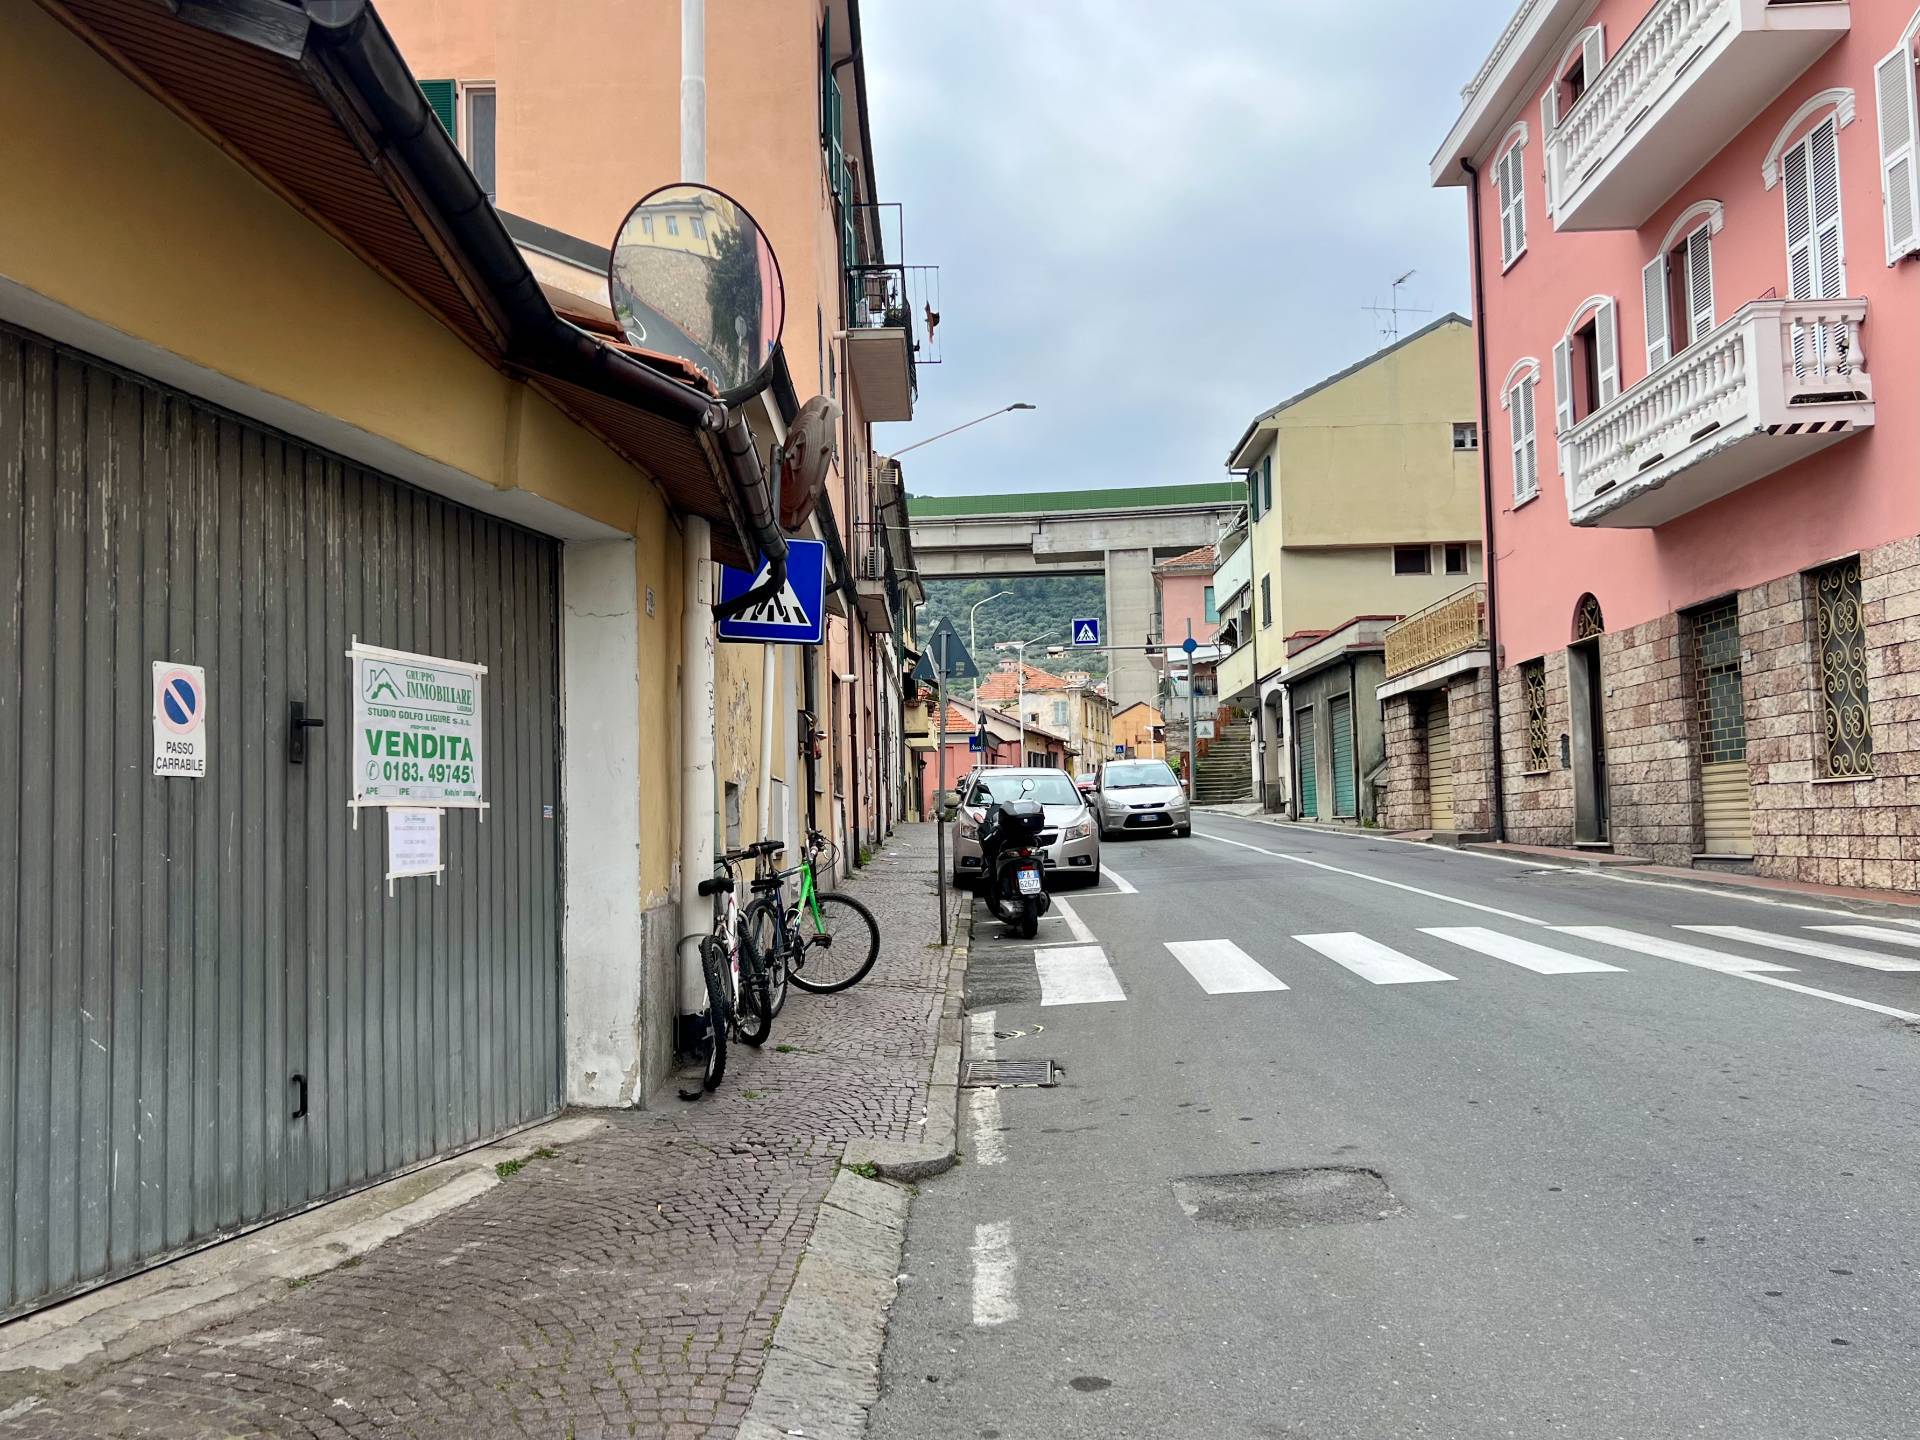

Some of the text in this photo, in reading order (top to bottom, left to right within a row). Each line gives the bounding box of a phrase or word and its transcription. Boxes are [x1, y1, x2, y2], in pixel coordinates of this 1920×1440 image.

[406, 669, 435, 682] GRUPPO
[406, 681, 472, 705] IMMOBILIARE
[367, 707, 396, 718] STUDIO
[398, 711, 423, 721] GOLFO
[425, 713, 451, 724] LIGURE
[166, 741, 194, 755] PASSO
[365, 729, 473, 761] VENDITA
[155, 756, 203, 772] CARRABILE
[383, 760, 424, 782] 0183.
